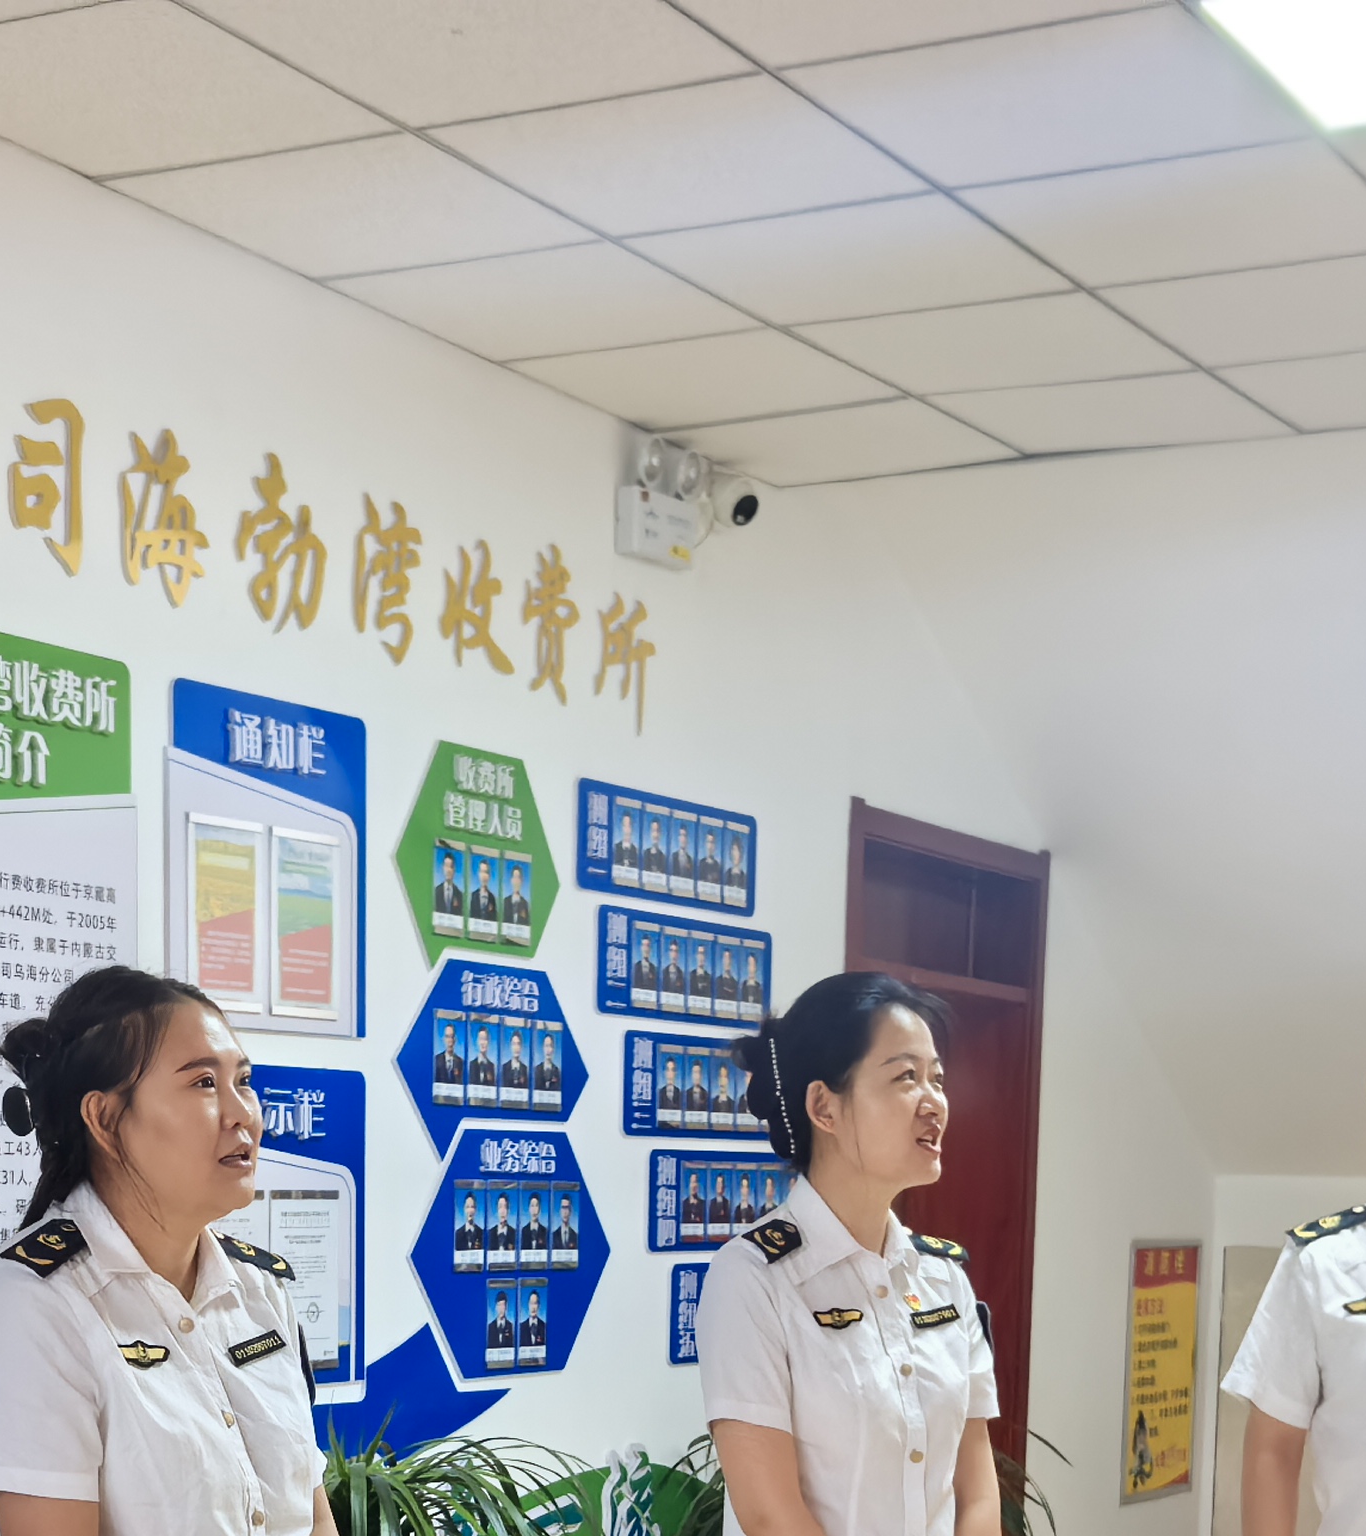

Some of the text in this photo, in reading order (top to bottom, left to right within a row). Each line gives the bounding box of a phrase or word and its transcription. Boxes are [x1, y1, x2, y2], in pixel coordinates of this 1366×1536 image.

[228, 708, 326, 776] 通知栏
[454, 754, 515, 798] 收费所
[444, 791, 522, 841] 管理人员
